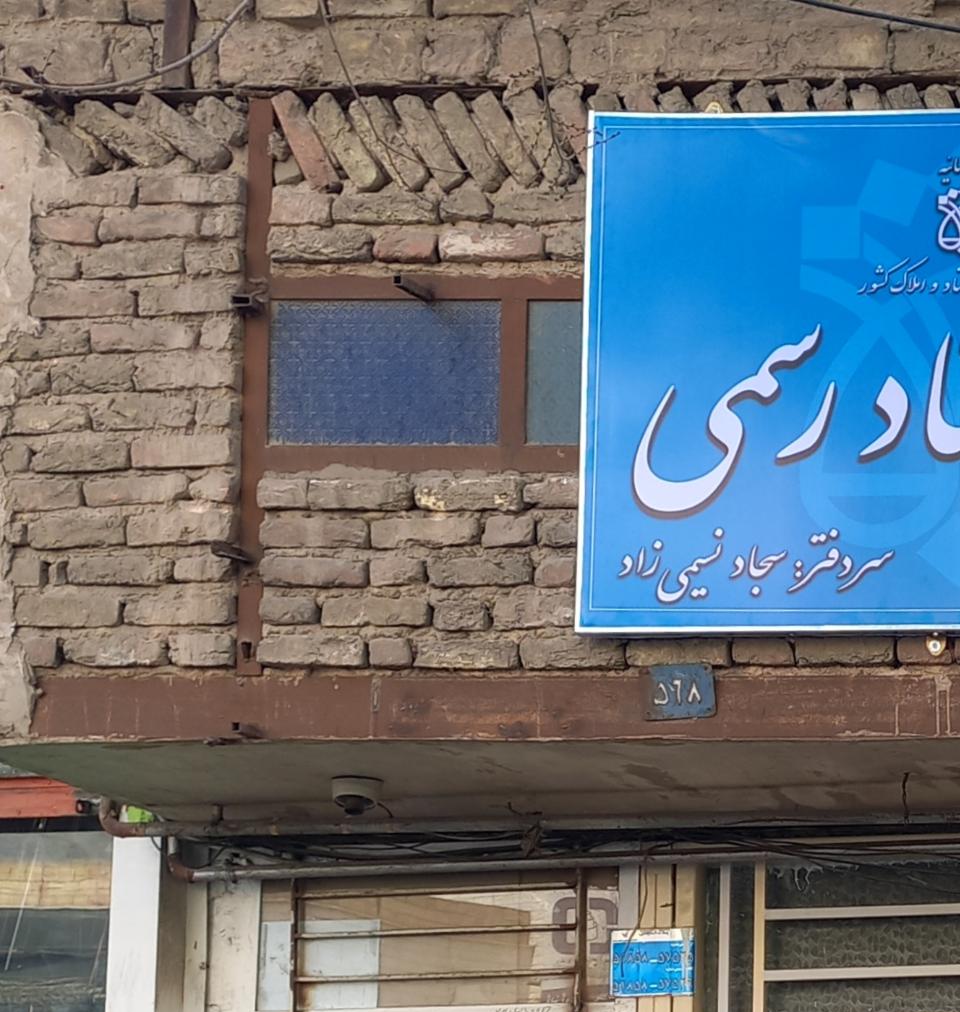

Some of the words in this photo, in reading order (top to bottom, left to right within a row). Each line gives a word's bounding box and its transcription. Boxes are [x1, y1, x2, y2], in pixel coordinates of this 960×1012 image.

[857, 257, 910, 296] کشور
[889, 257, 928, 293] املاک
[930, 282, 938, 293] و
[632, 323, 837, 517] رسمی
[617, 540, 663, 577] زاد
[656, 527, 724, 605] نسیمی
[729, 545, 788, 597] سجاد
